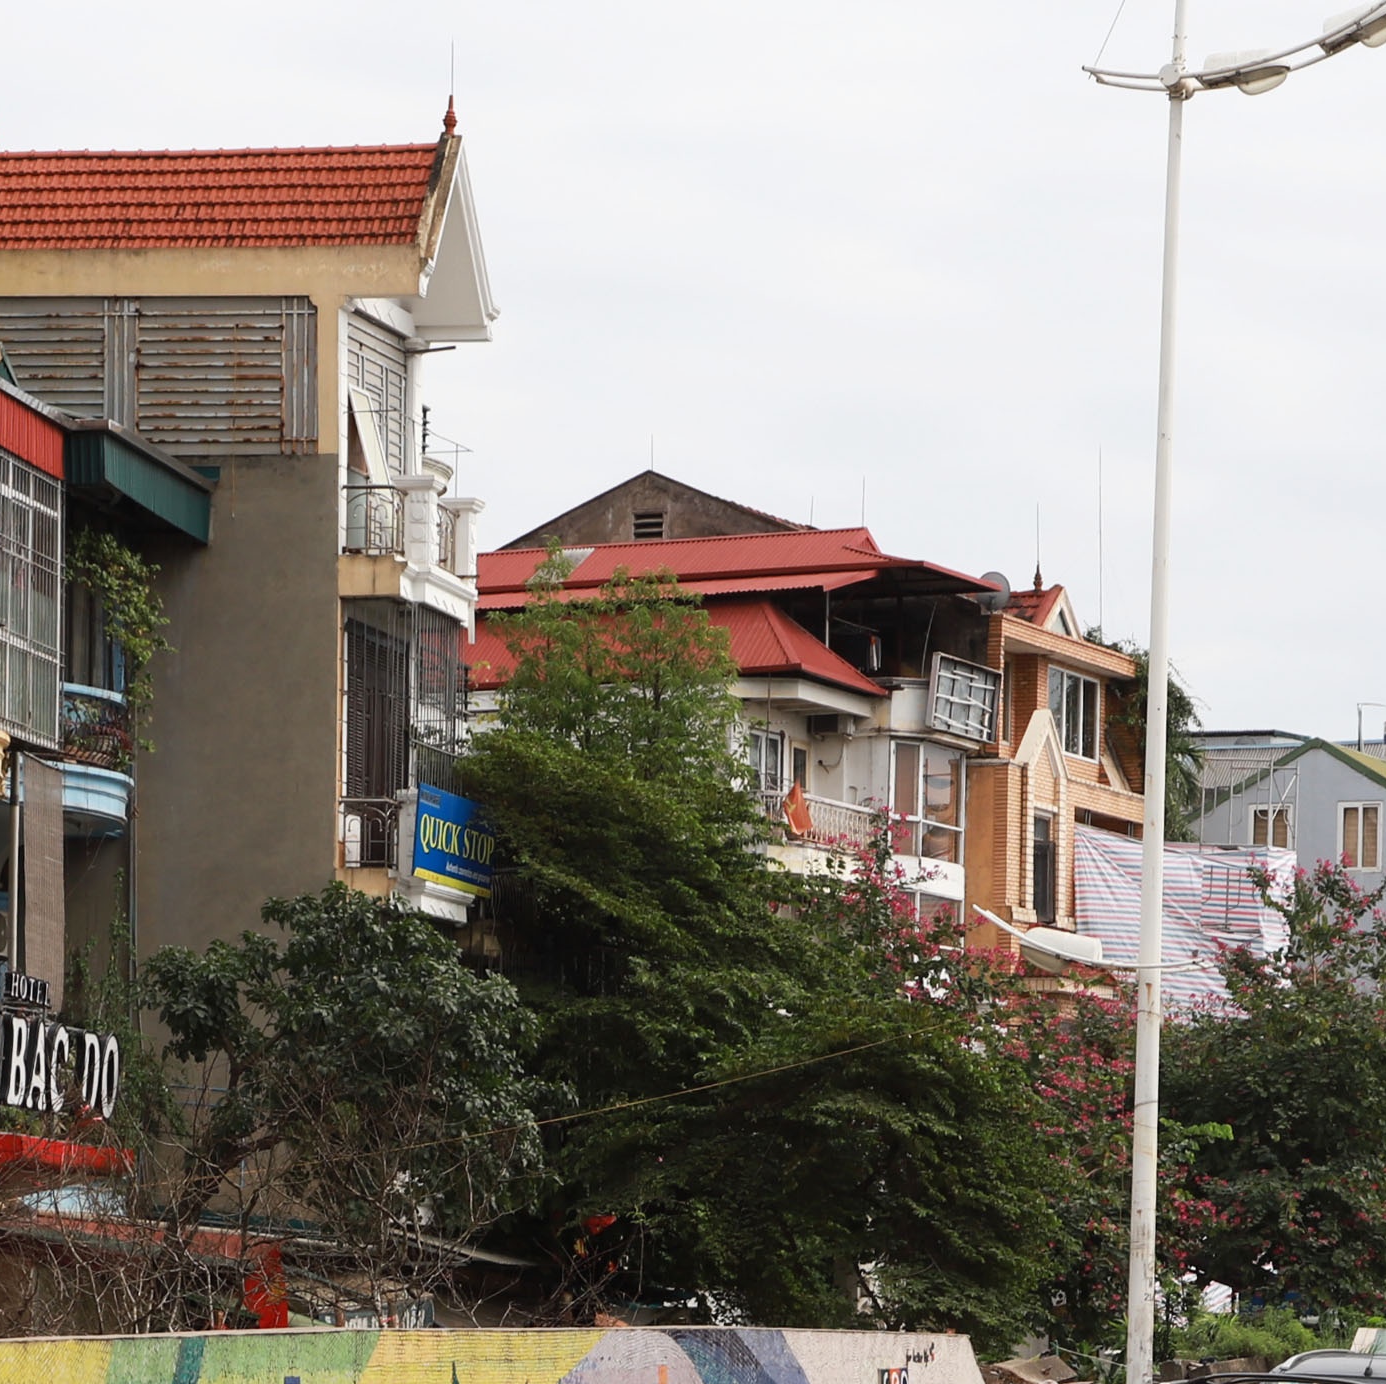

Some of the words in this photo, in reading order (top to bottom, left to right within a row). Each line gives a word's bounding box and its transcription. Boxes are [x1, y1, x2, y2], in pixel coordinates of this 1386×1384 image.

[420, 813, 462, 856] QUICK
[463, 828, 495, 865] STOP
[11, 973, 51, 1006] HOTEL
